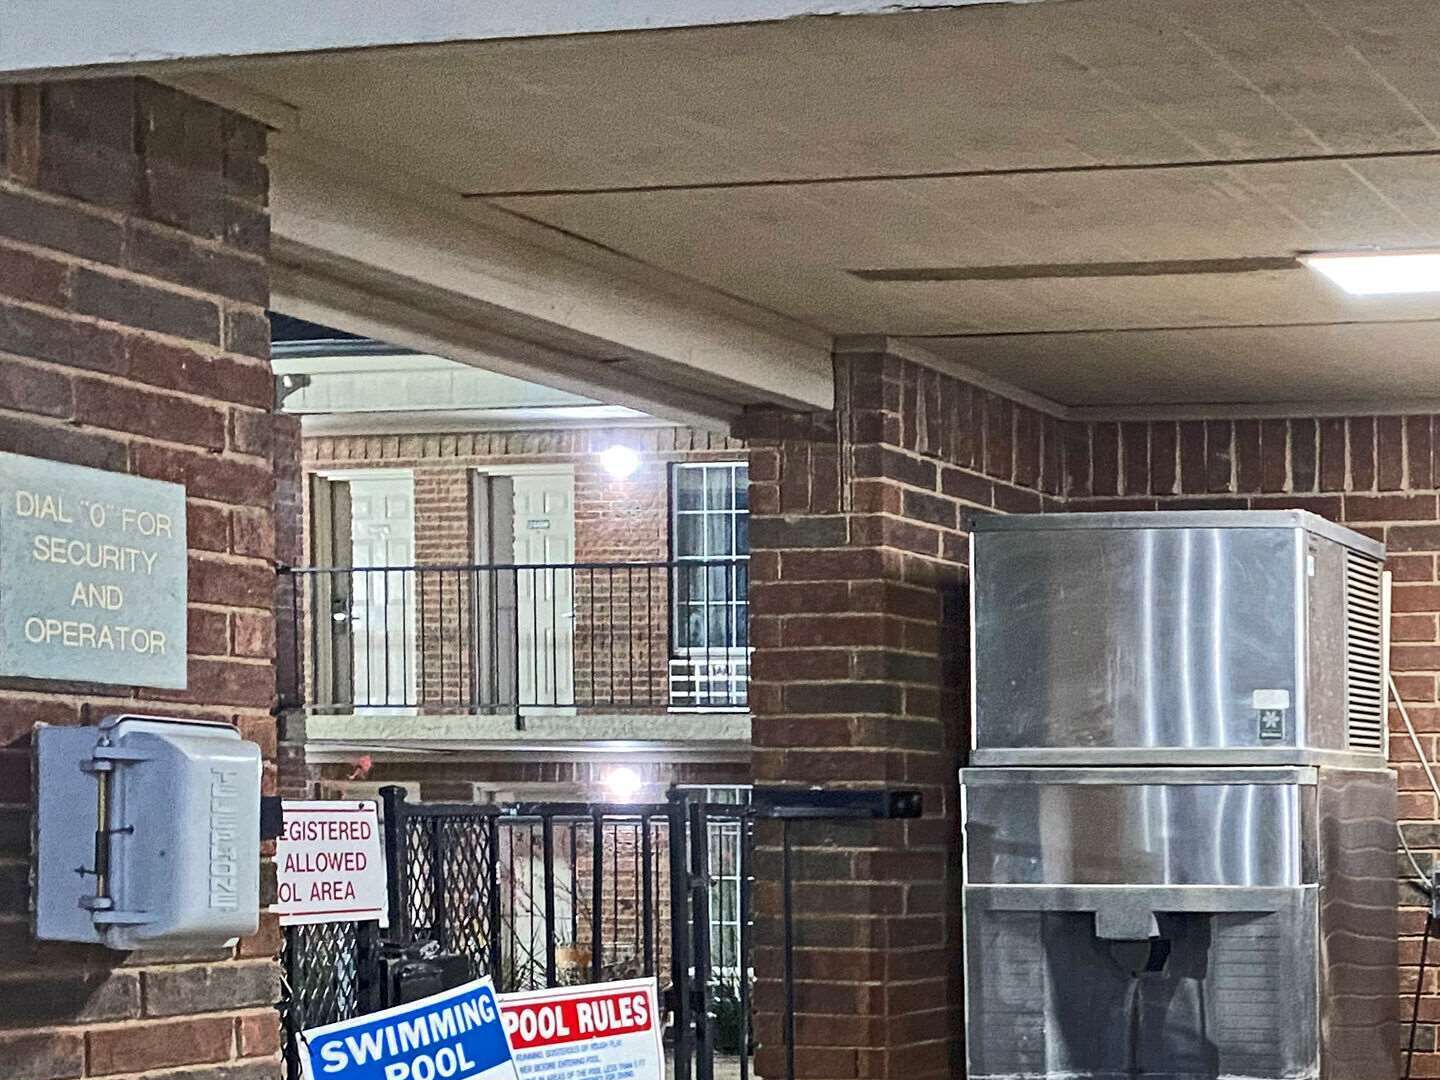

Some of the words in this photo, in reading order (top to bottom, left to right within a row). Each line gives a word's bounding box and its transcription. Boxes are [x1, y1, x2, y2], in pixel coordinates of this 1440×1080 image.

[16, 490, 72, 523] DIAL
[122, 508, 172, 538] FOR
[32, 535, 157, 575] SECURITY
[71, 581, 123, 610] AND
[25, 617, 166, 655] OPERATOR
[284, 852, 367, 873] ALLOWED
[310, 880, 356, 901] AREA
[320, 994, 496, 1073] SWIMMING
[501, 1005, 570, 1042] POOL
[575, 995, 648, 1034] RULES
